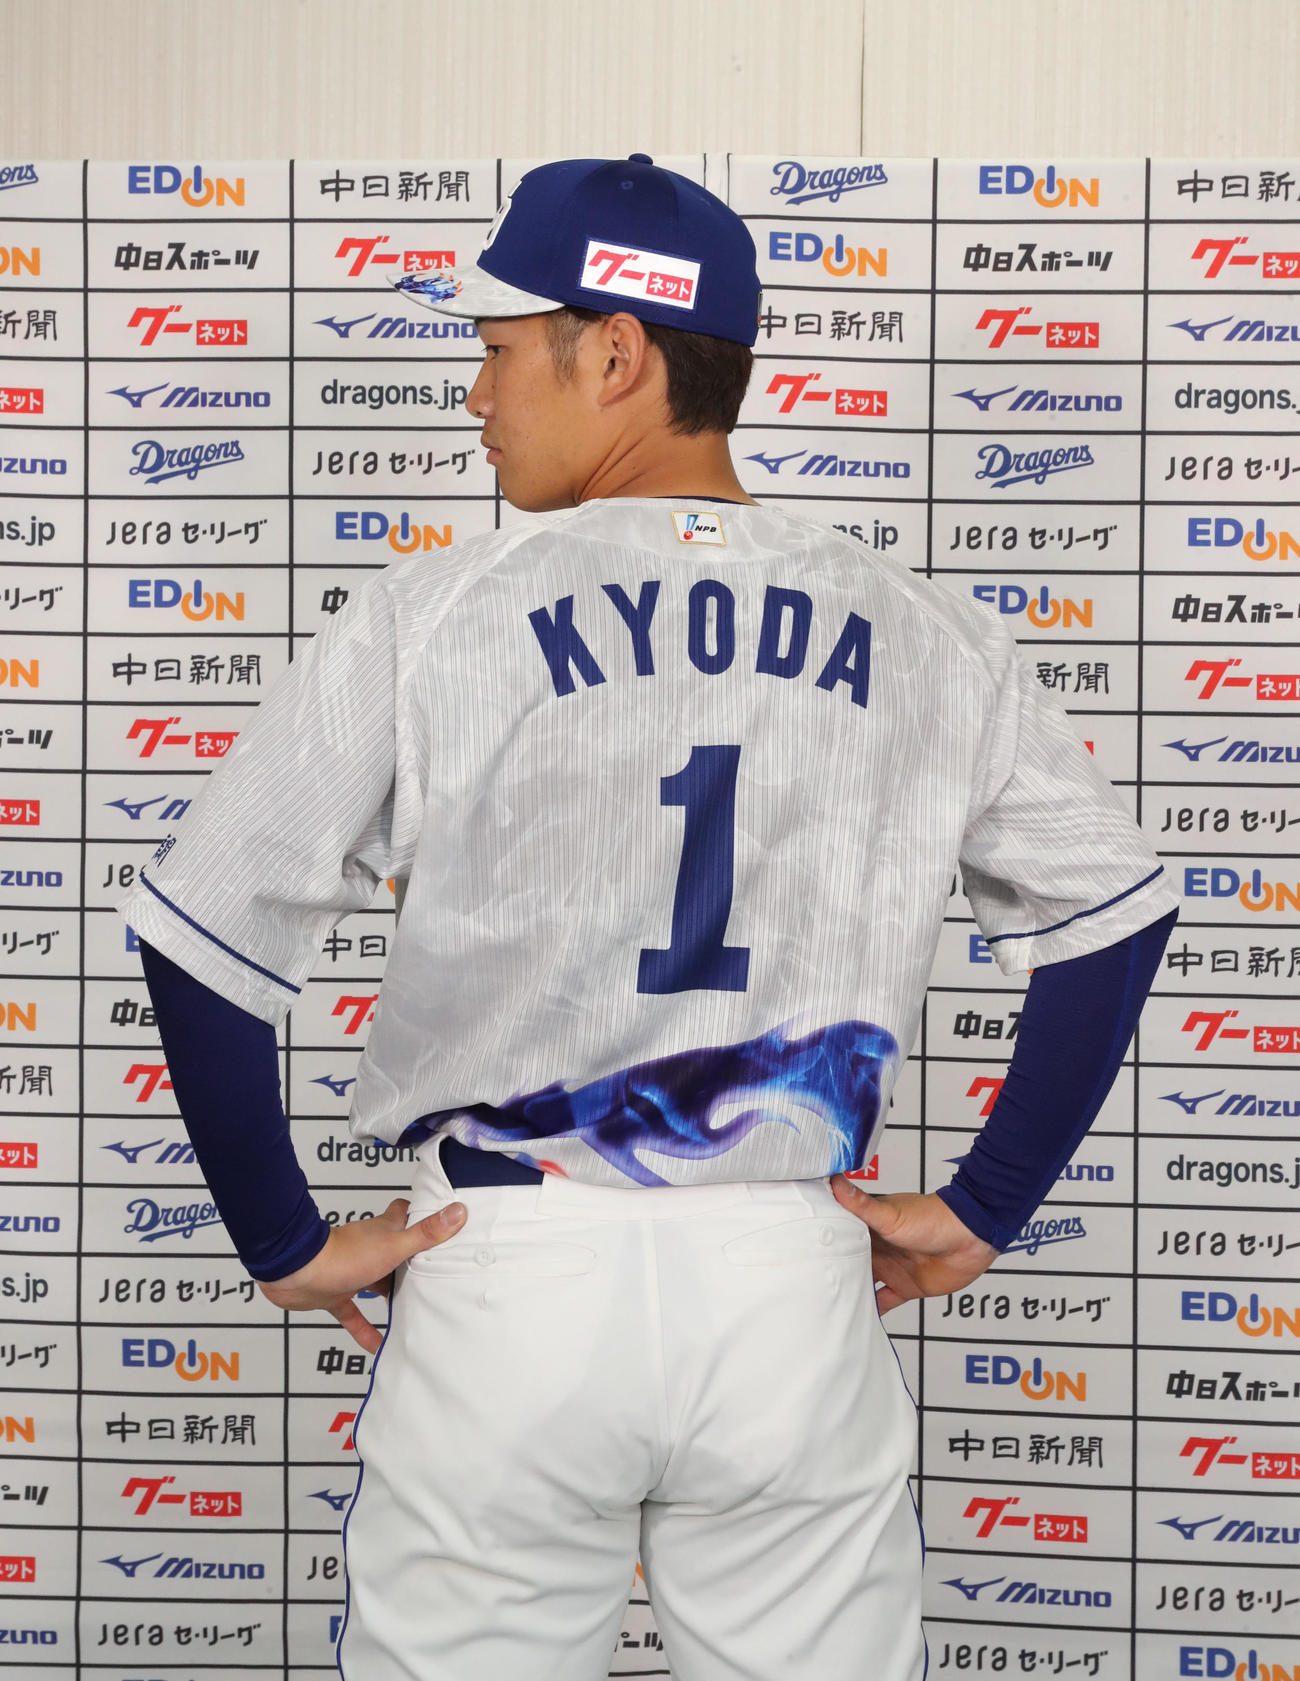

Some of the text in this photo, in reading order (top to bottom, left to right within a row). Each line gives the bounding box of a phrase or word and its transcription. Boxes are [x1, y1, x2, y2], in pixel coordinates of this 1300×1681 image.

[320, 170, 469, 202] 中日新聞
[771, 162, 887, 205] Dragons
[1178, 170, 1300, 202] 中日新
[115, 243, 259, 270] 中日スポーツ
[964, 244, 1112, 271] 中日スポーツ
[1192, 237, 1300, 278] グーネッ
[0, 310, 57, 340] 新聞
[759, 306, 904, 343] 中日新聞
[0, 388, 43, 414] ネット
[321, 380, 467, 411] dragons.jp
[1175, 383, 1300, 414] dragons.
[130, 441, 244, 484] Dragons
[975, 444, 1094, 488] Dragons
[695, 525, 717, 533] NPB
[5, 586, 63, 611] リーグ
[1172, 594, 1300, 623] 中日スポー
[528, 579, 872, 709] KYODA
[112, 653, 260, 685] 中日新聞
[1036, 662, 1109, 694] 新聞
[636, 745, 750, 994] 1
[2, 930, 59, 955] リーグ
[322, 929, 386, 962] 中日
[1167, 1155, 1300, 1189] dragons.j
[0, 1344, 57, 1367] リーグ
[1166, 1370, 1300, 1401] 中日スポー
[106, 1412, 255, 1445] 中日新聞
[948, 1429, 1103, 1468] 中日新聞
